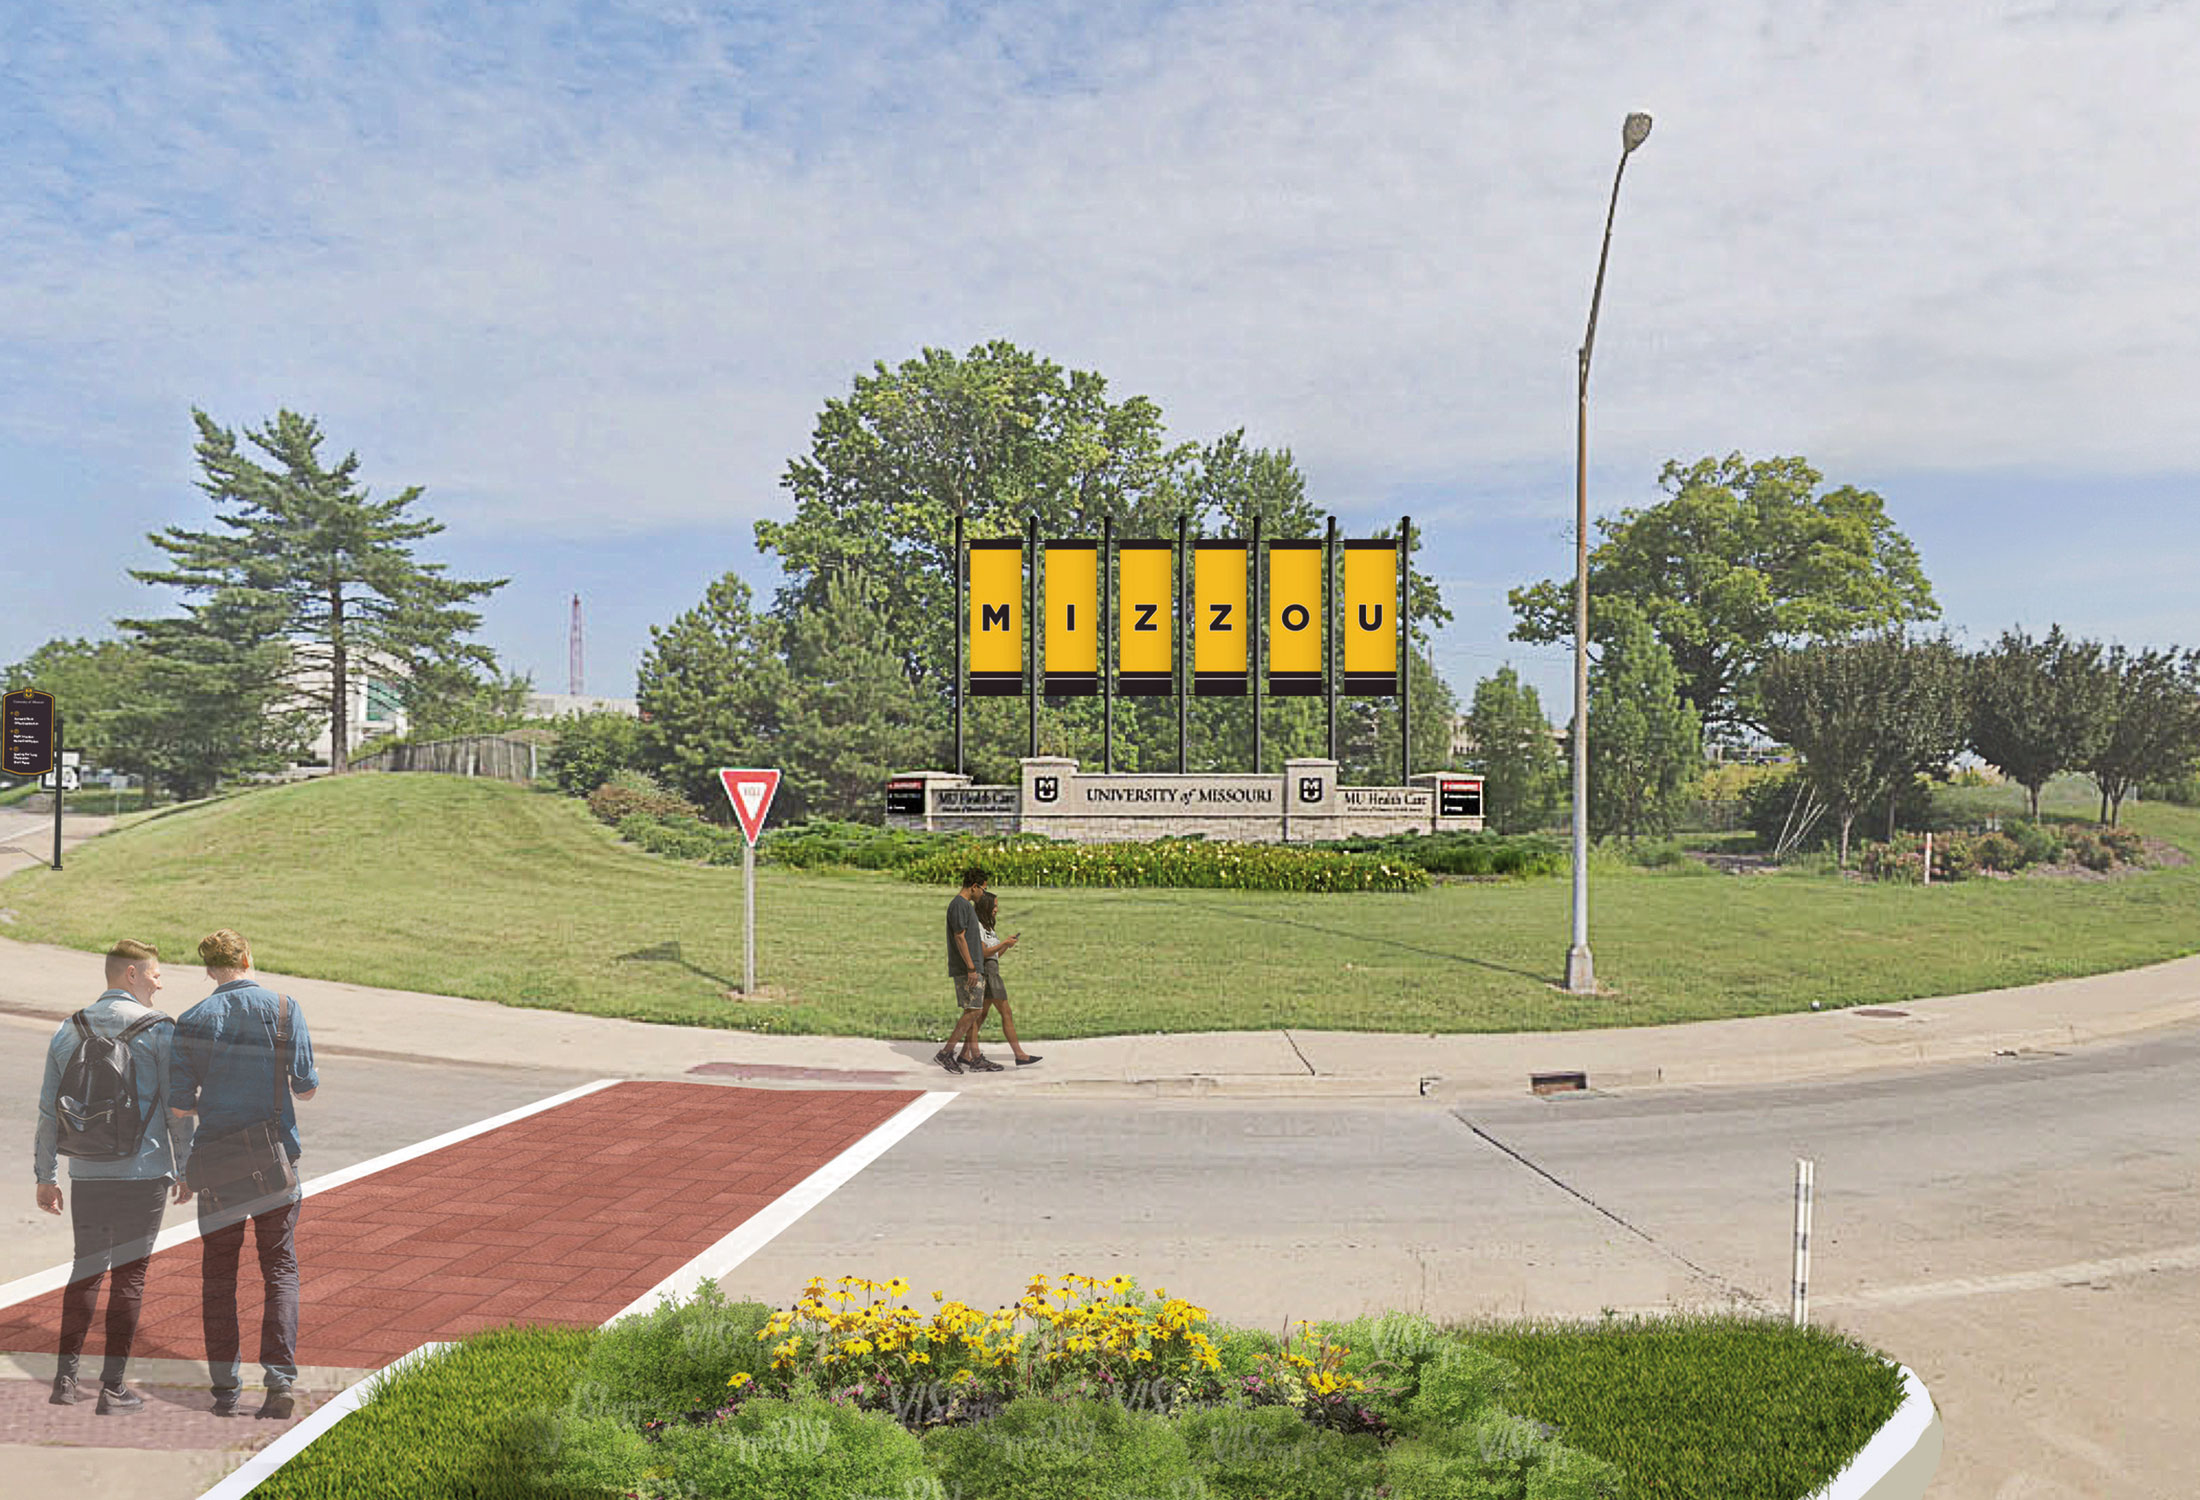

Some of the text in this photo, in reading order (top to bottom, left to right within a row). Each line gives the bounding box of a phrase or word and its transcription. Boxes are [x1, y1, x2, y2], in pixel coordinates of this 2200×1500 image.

[1086, 788, 1272, 806] UNIVERSITY of MISSOURI
